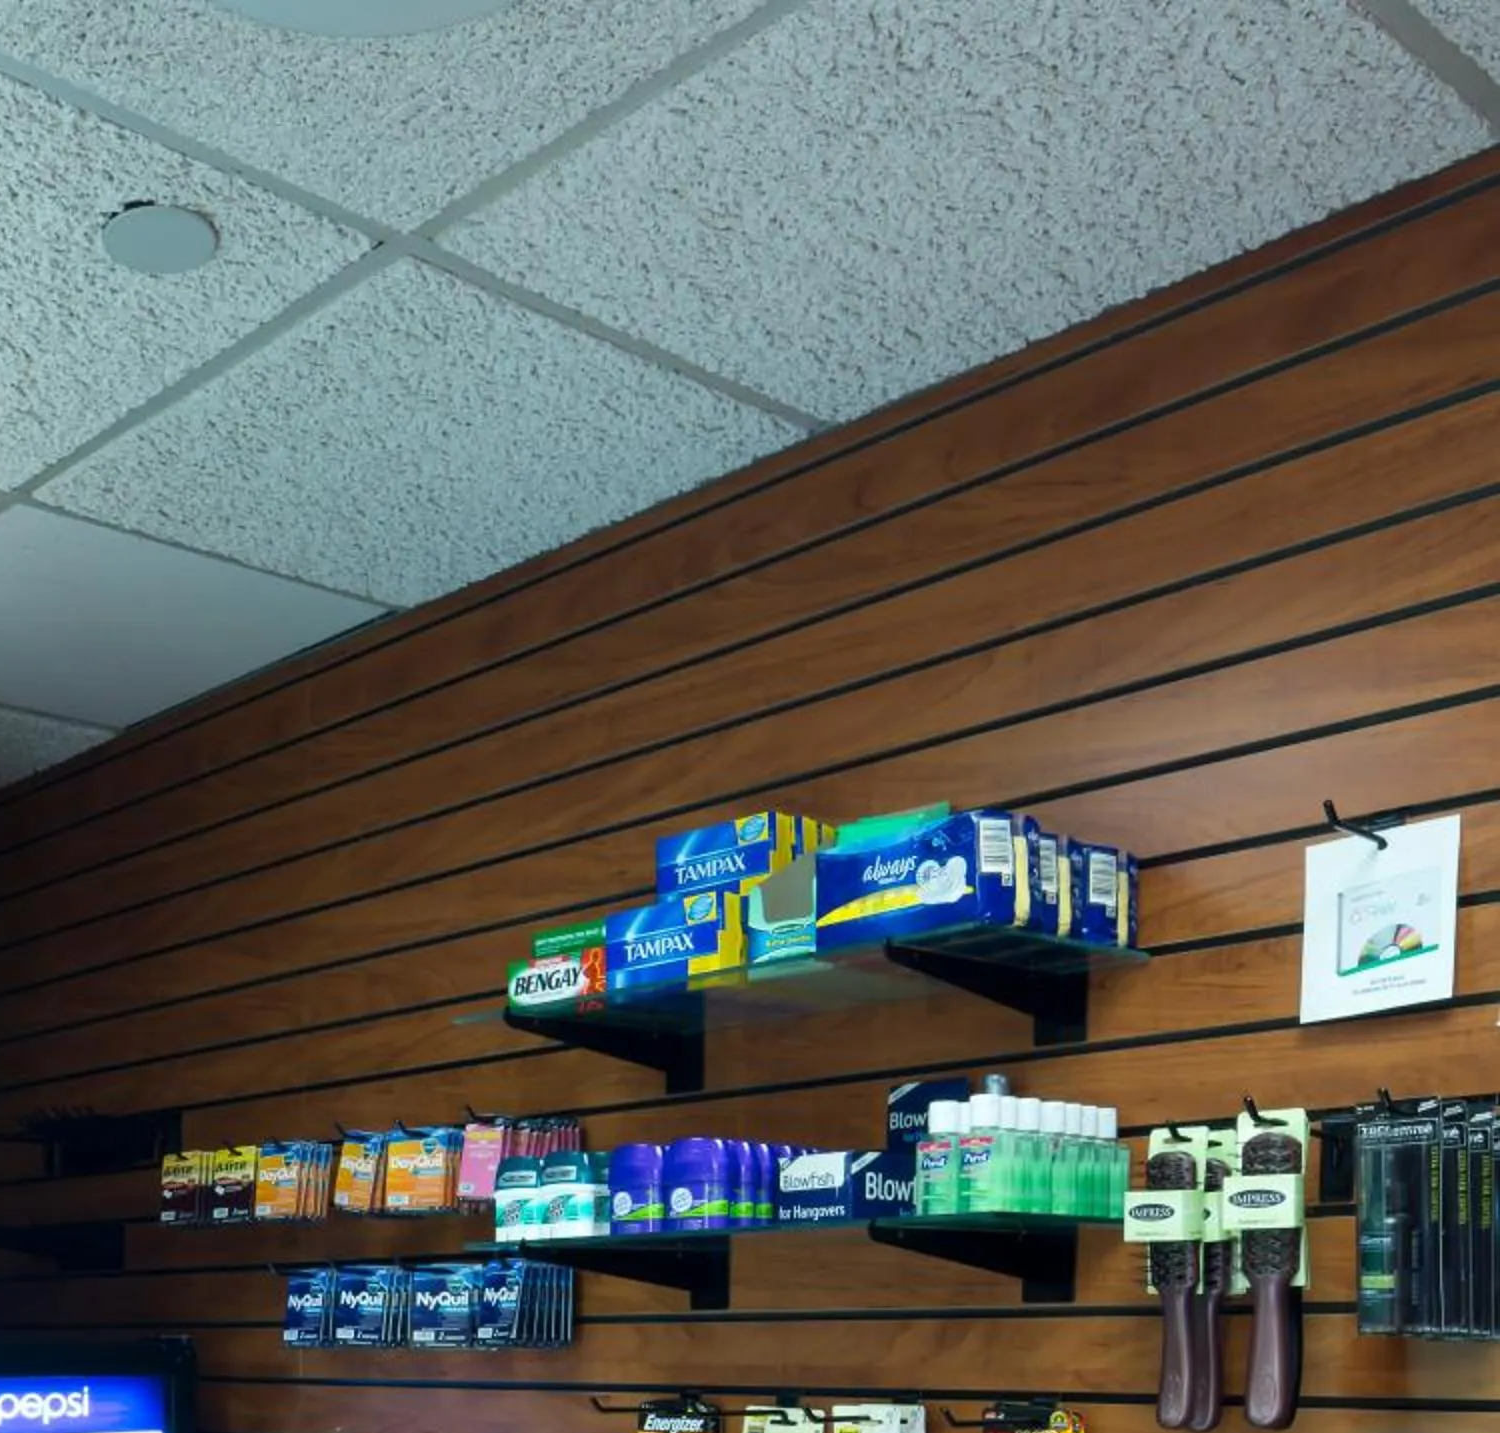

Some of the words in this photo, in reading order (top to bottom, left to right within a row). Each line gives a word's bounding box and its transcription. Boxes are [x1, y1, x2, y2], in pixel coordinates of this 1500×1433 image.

[674, 851, 747, 885] TAMPAX
[862, 855, 917, 884] always
[623, 932, 695, 963] TAMPAX
[513, 967, 583, 996] BENGAY
[889, 1110, 929, 1130] Blow
[782, 1172, 836, 1190] Blowfish
[864, 1171, 919, 1206] Blowf
[778, 1206, 792, 1220] for
[793, 1204, 846, 1221] Hangovers
[415, 1290, 469, 1311] NyQuil
